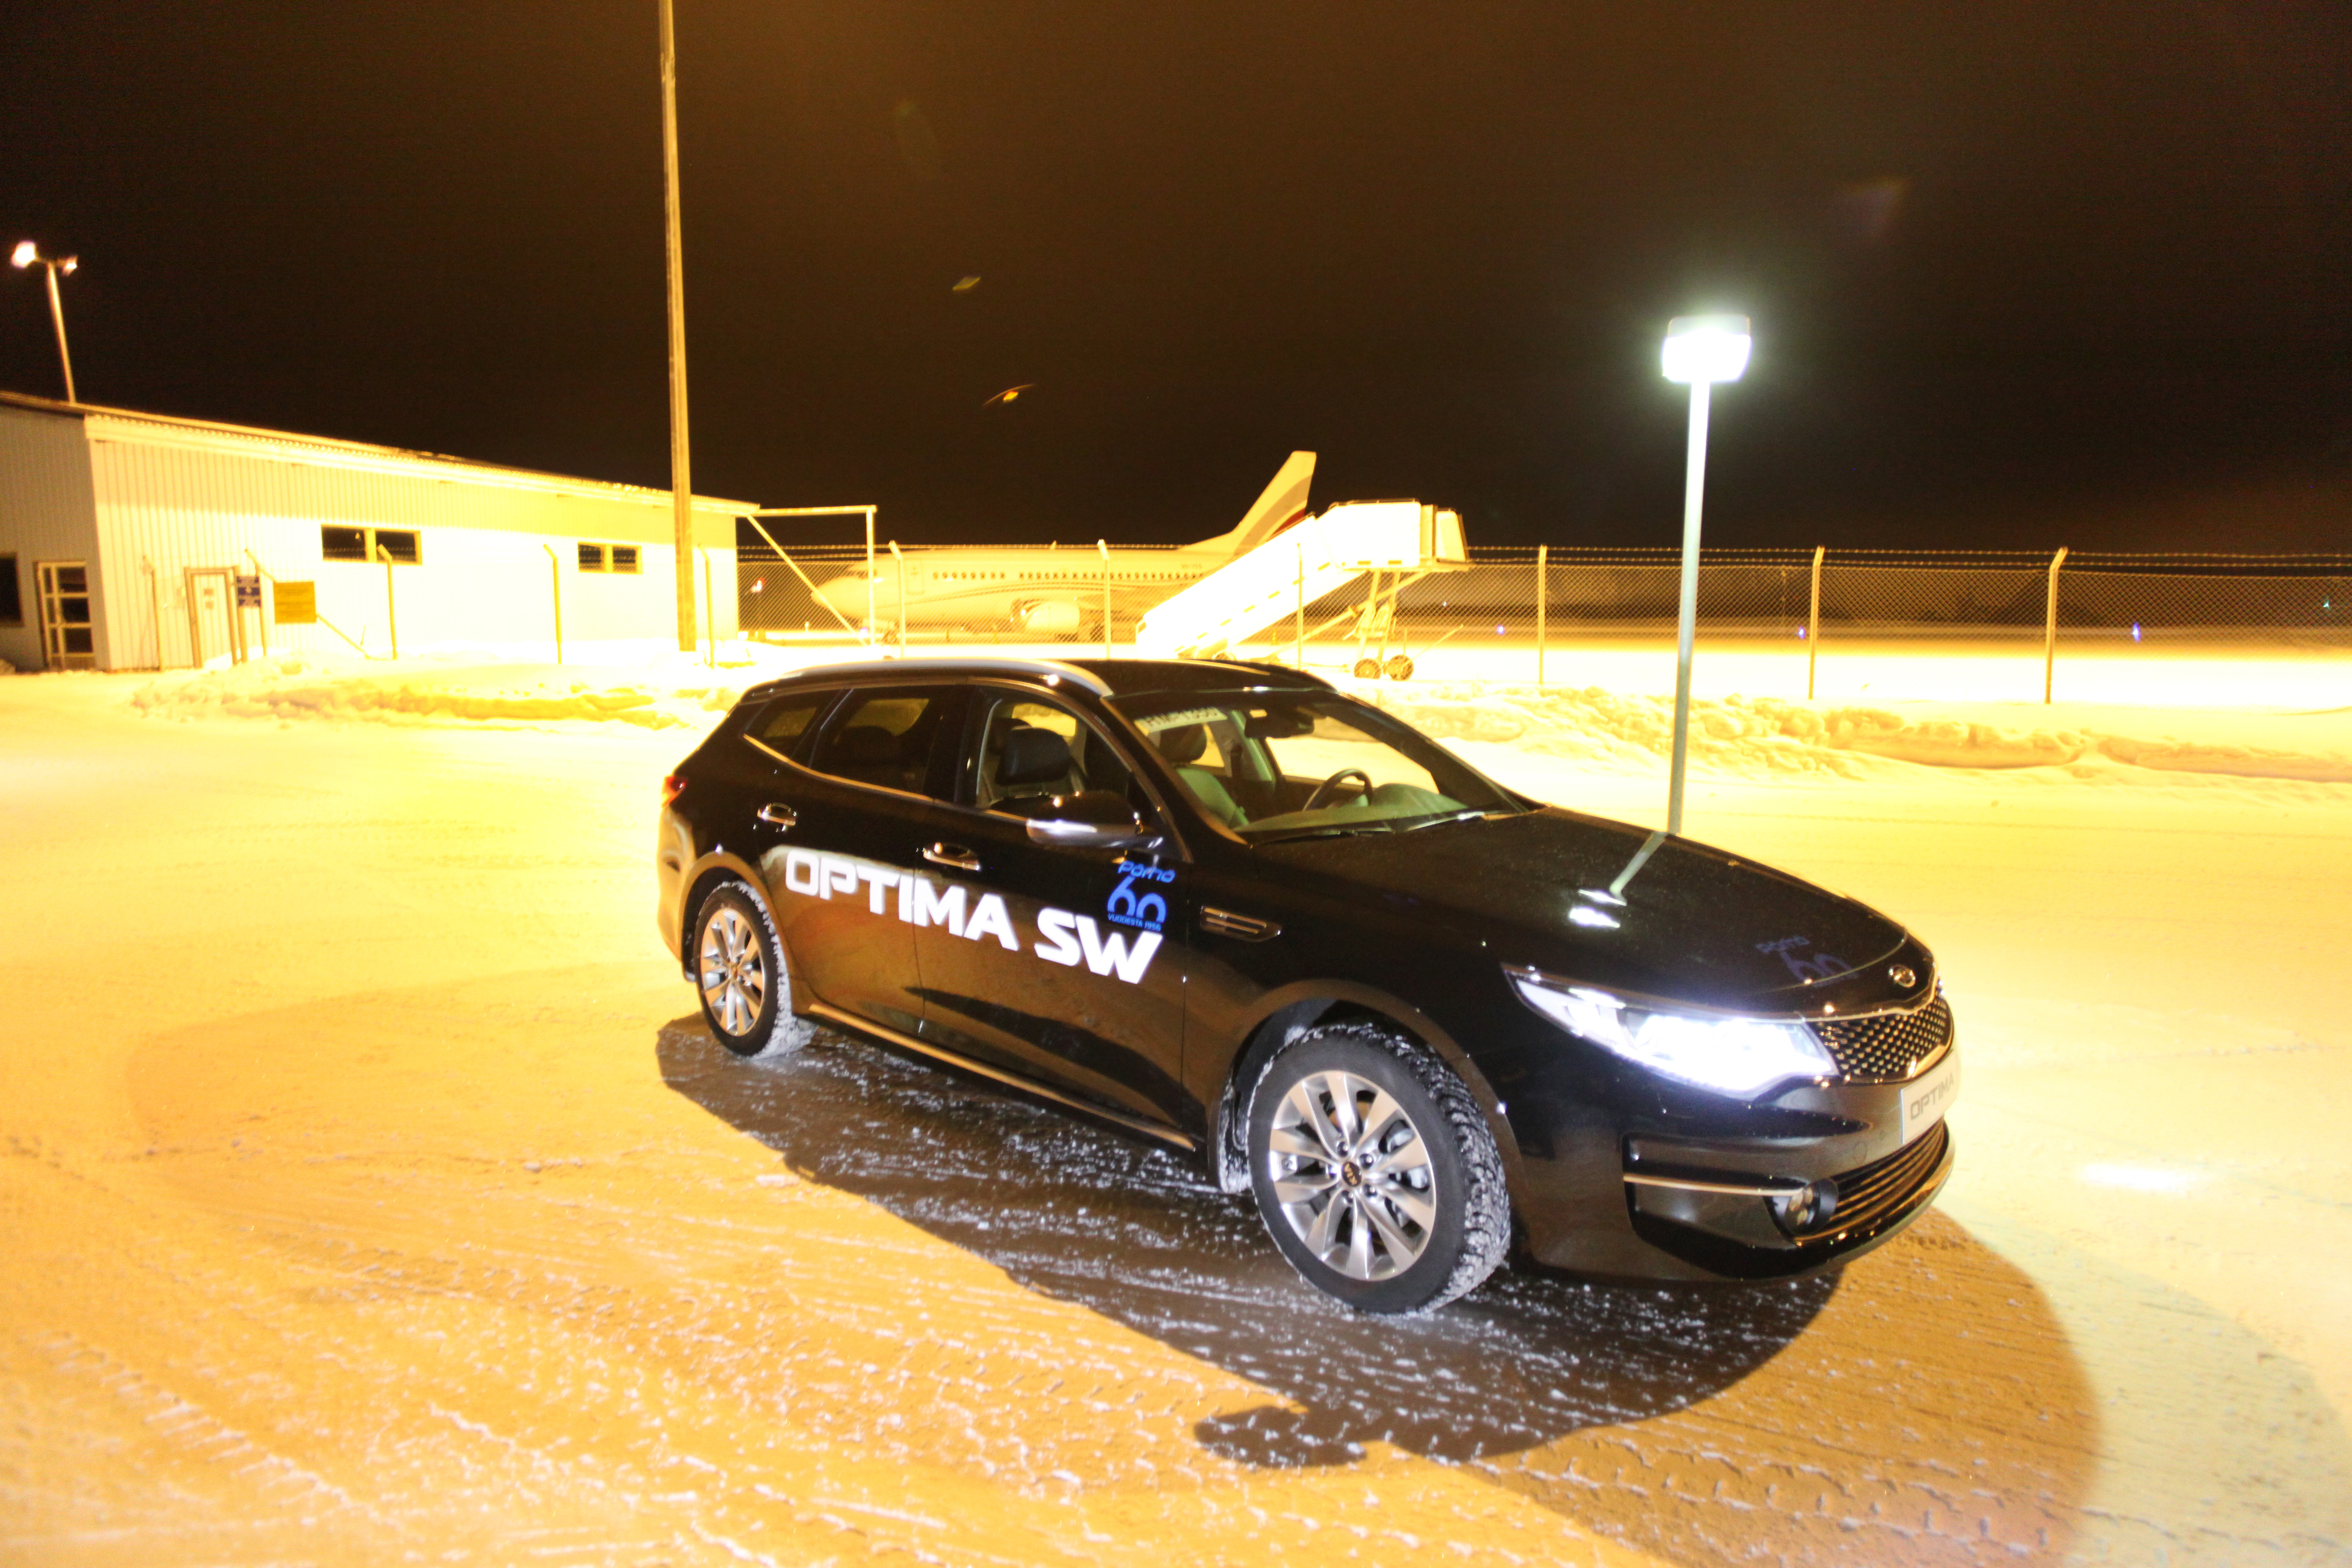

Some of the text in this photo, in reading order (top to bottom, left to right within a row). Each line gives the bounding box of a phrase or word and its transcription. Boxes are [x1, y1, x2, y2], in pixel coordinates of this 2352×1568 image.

[786, 851, 1163, 984] OPTIMA SW
[1911, 1071, 1954, 1121] OPTIMA
